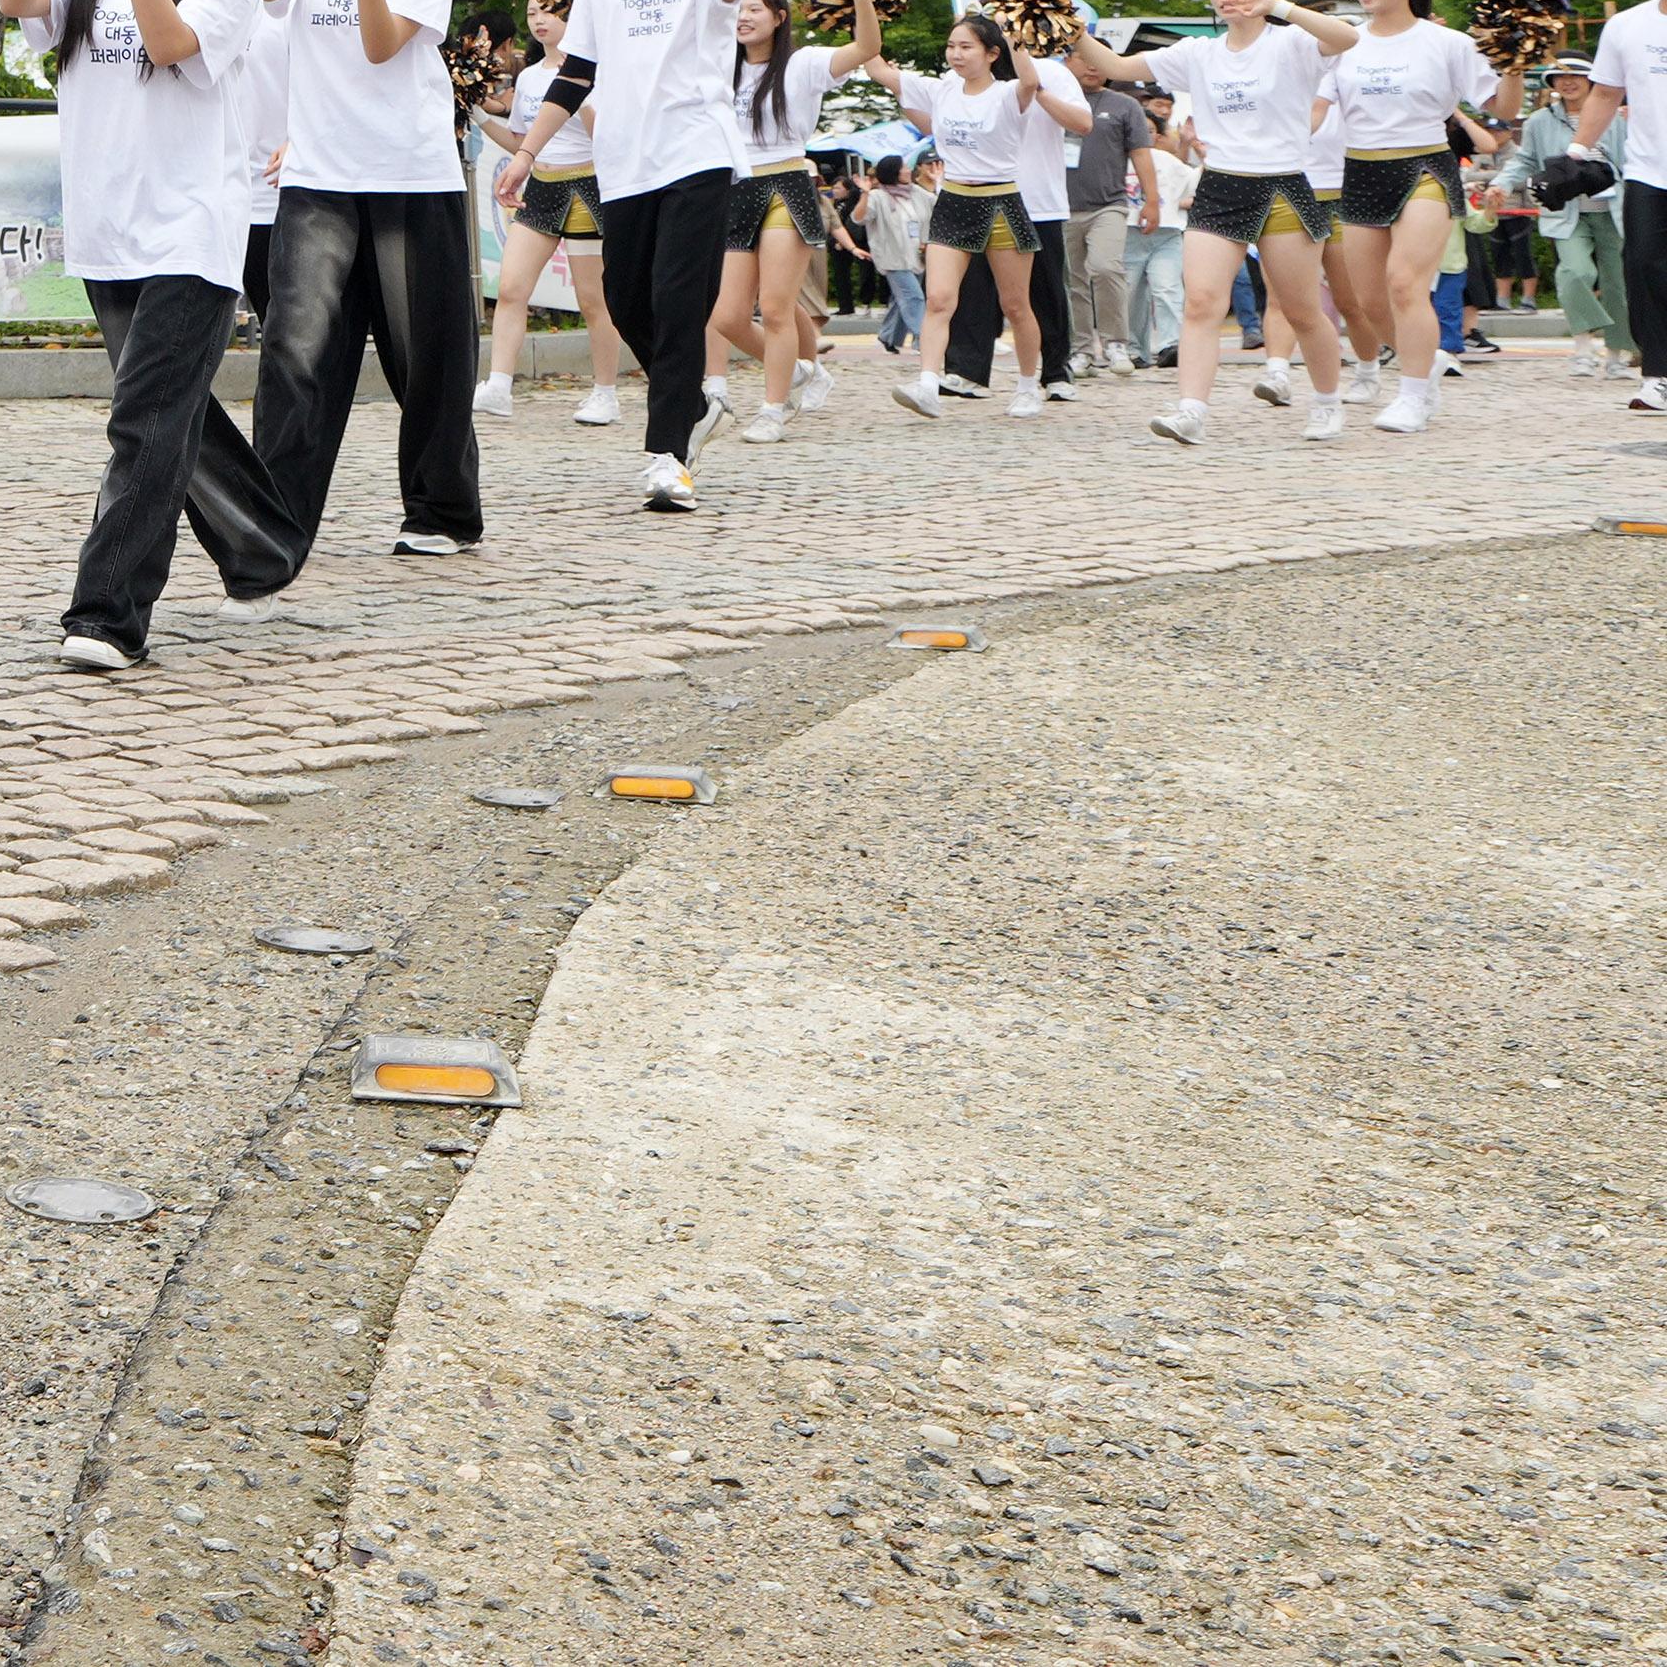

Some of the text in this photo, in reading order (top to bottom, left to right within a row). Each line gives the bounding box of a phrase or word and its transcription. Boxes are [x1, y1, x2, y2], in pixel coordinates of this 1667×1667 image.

[639, 10, 664, 23] 대동
[105, 26, 137, 45] 대동
[627, 22, 674, 38] 퍼레이드
